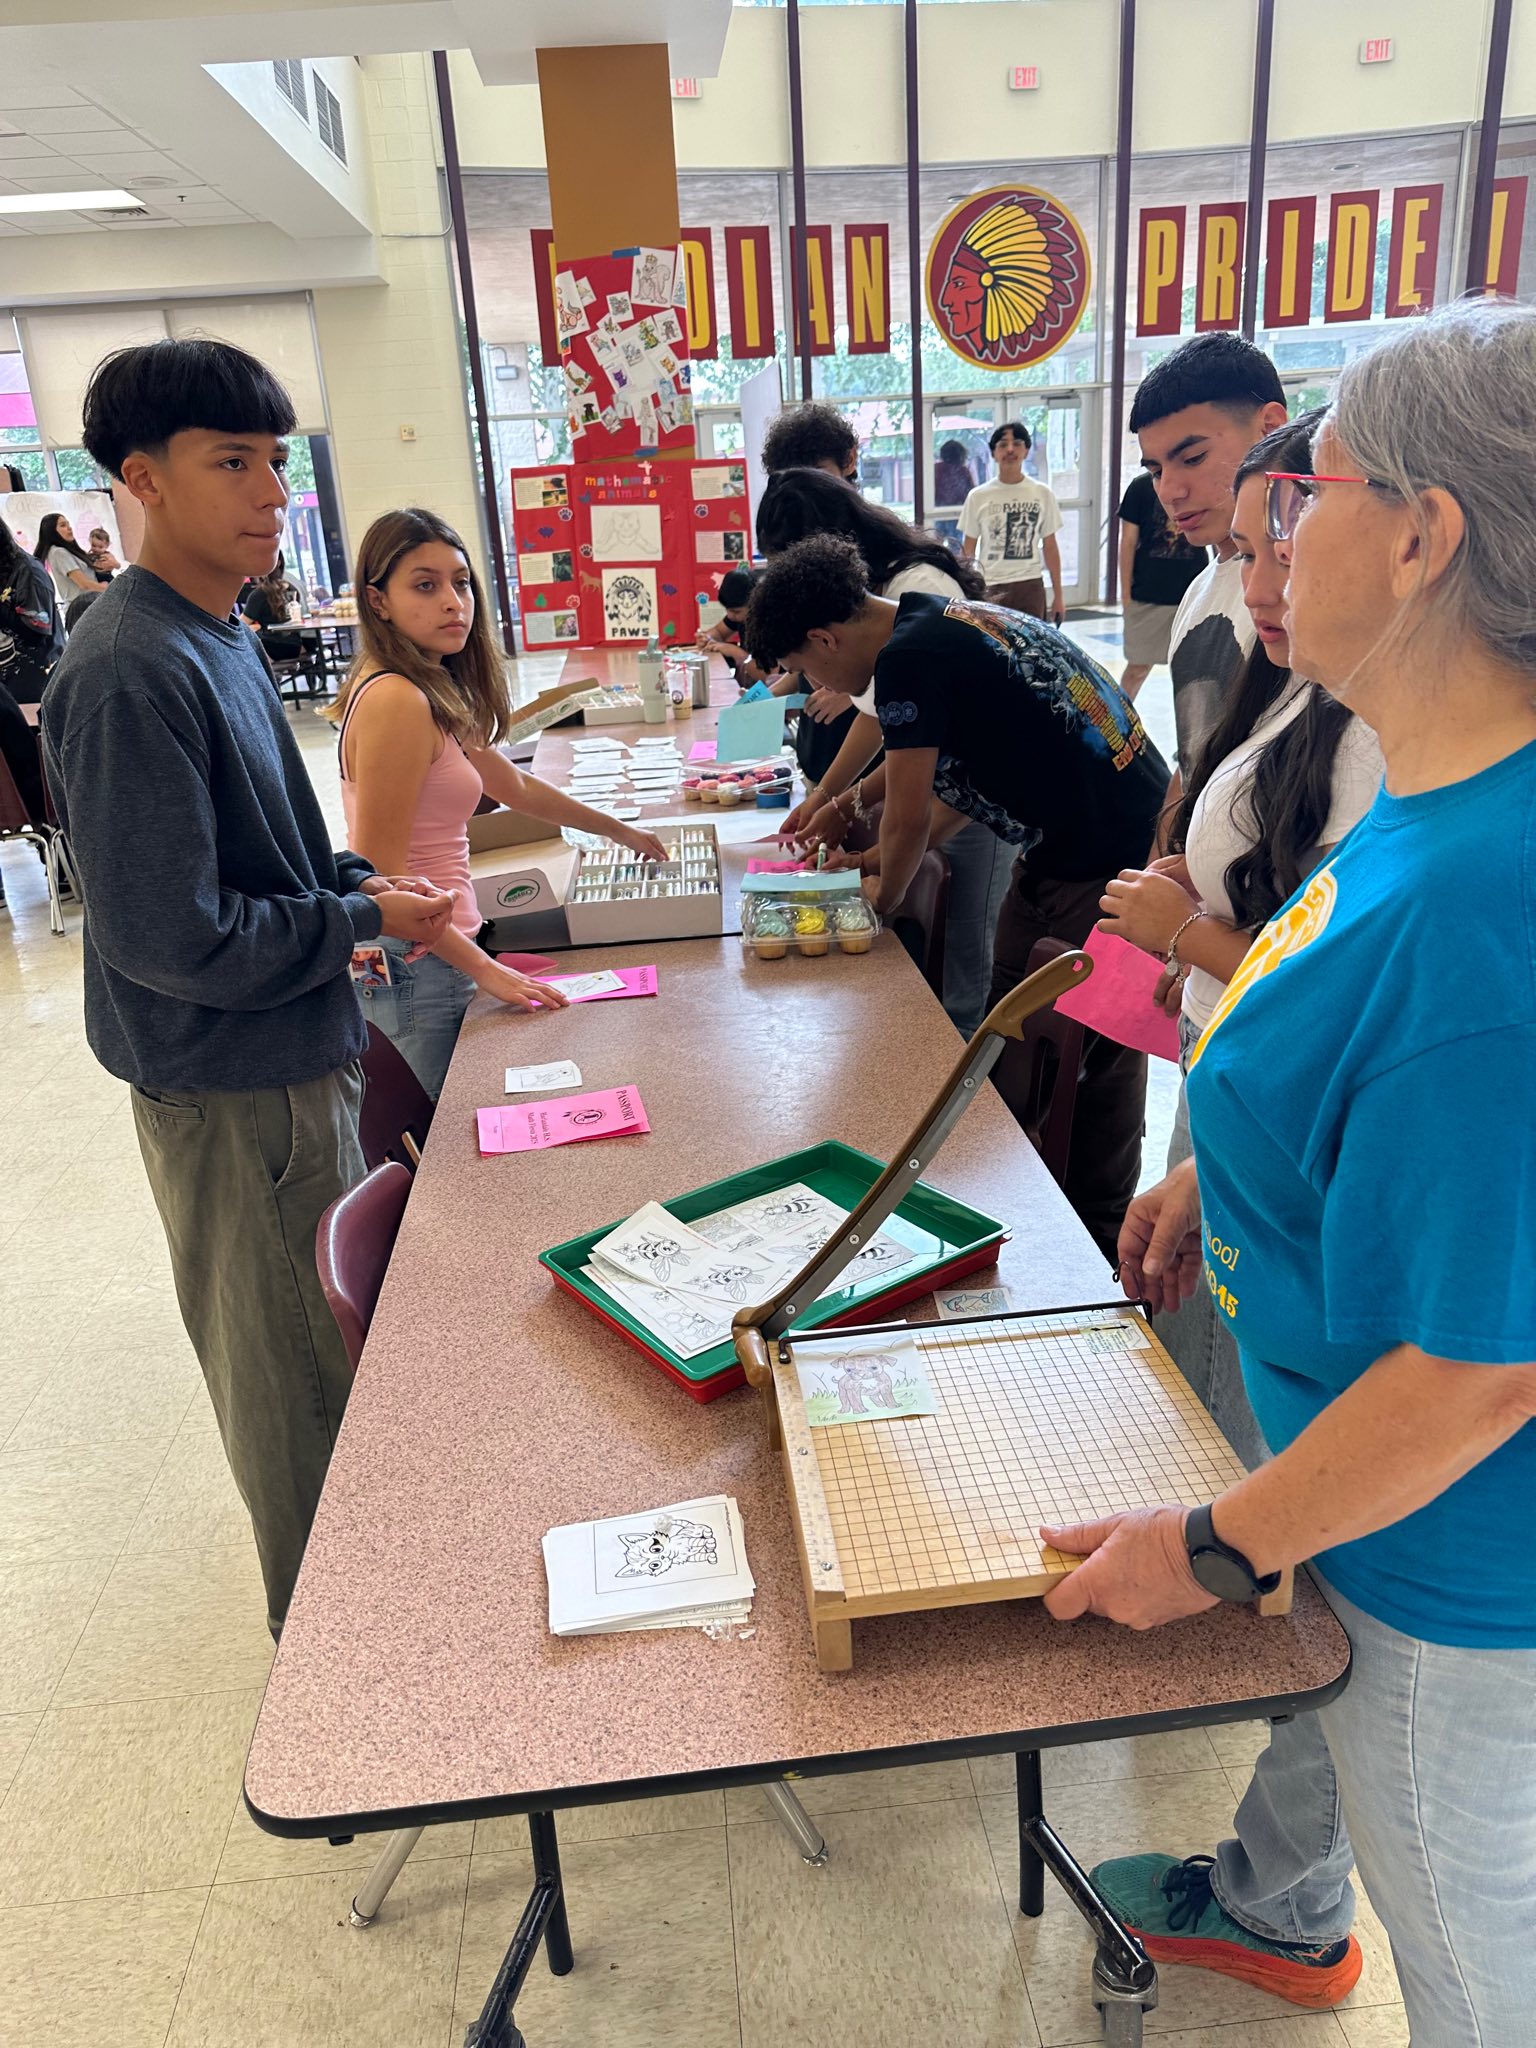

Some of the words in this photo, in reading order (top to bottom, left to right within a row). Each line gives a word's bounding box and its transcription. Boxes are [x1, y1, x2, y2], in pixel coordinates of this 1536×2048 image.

[1366, 39, 1391, 61] EXIT
[1015, 66, 1037, 88] EXIT
[611, 627, 650, 638] PAWS
[616, 1089, 636, 1121] PASSPORT
